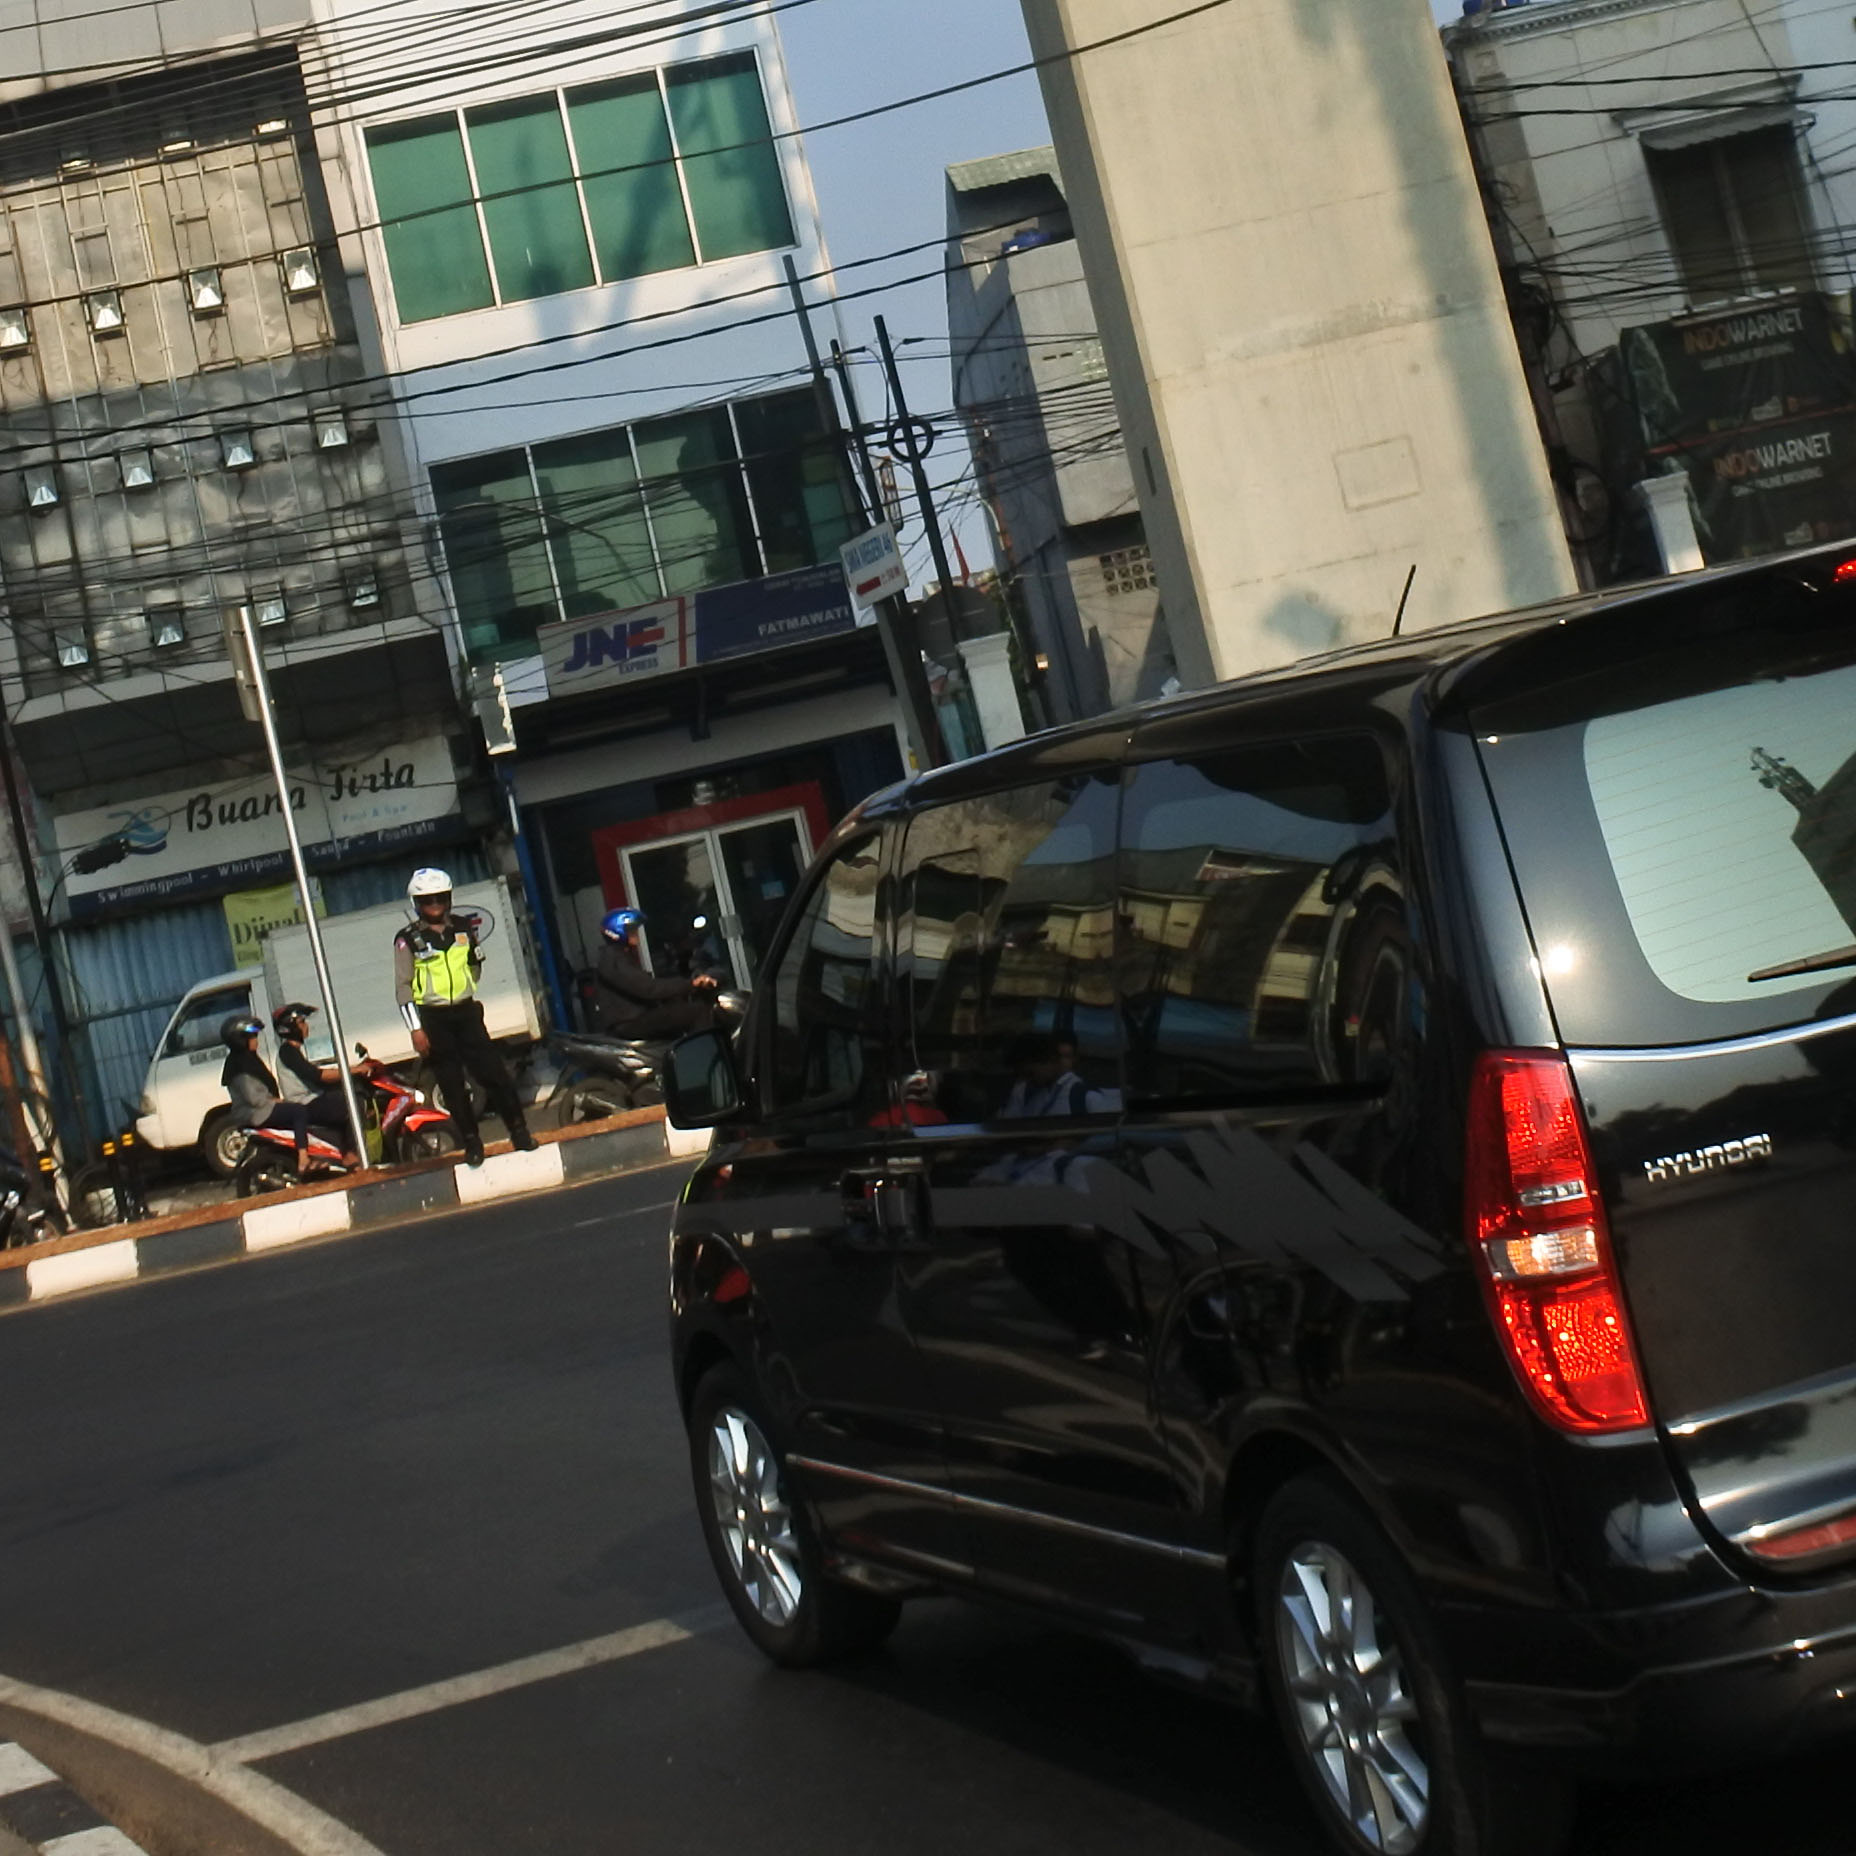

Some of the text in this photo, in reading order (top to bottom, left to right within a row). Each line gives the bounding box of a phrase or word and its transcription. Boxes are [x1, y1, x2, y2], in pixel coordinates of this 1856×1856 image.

[1713, 432, 1832, 478] INDOWARNET
[562, 616, 666, 673] JNE
[757, 605, 850, 638] FATMAWATI
[326, 757, 416, 801] Tirta
[97, 873, 194, 905] Swimmingpool
[218, 854, 285, 879] Whirlpool
[1644, 1132, 1773, 1183] HYUNDAI
